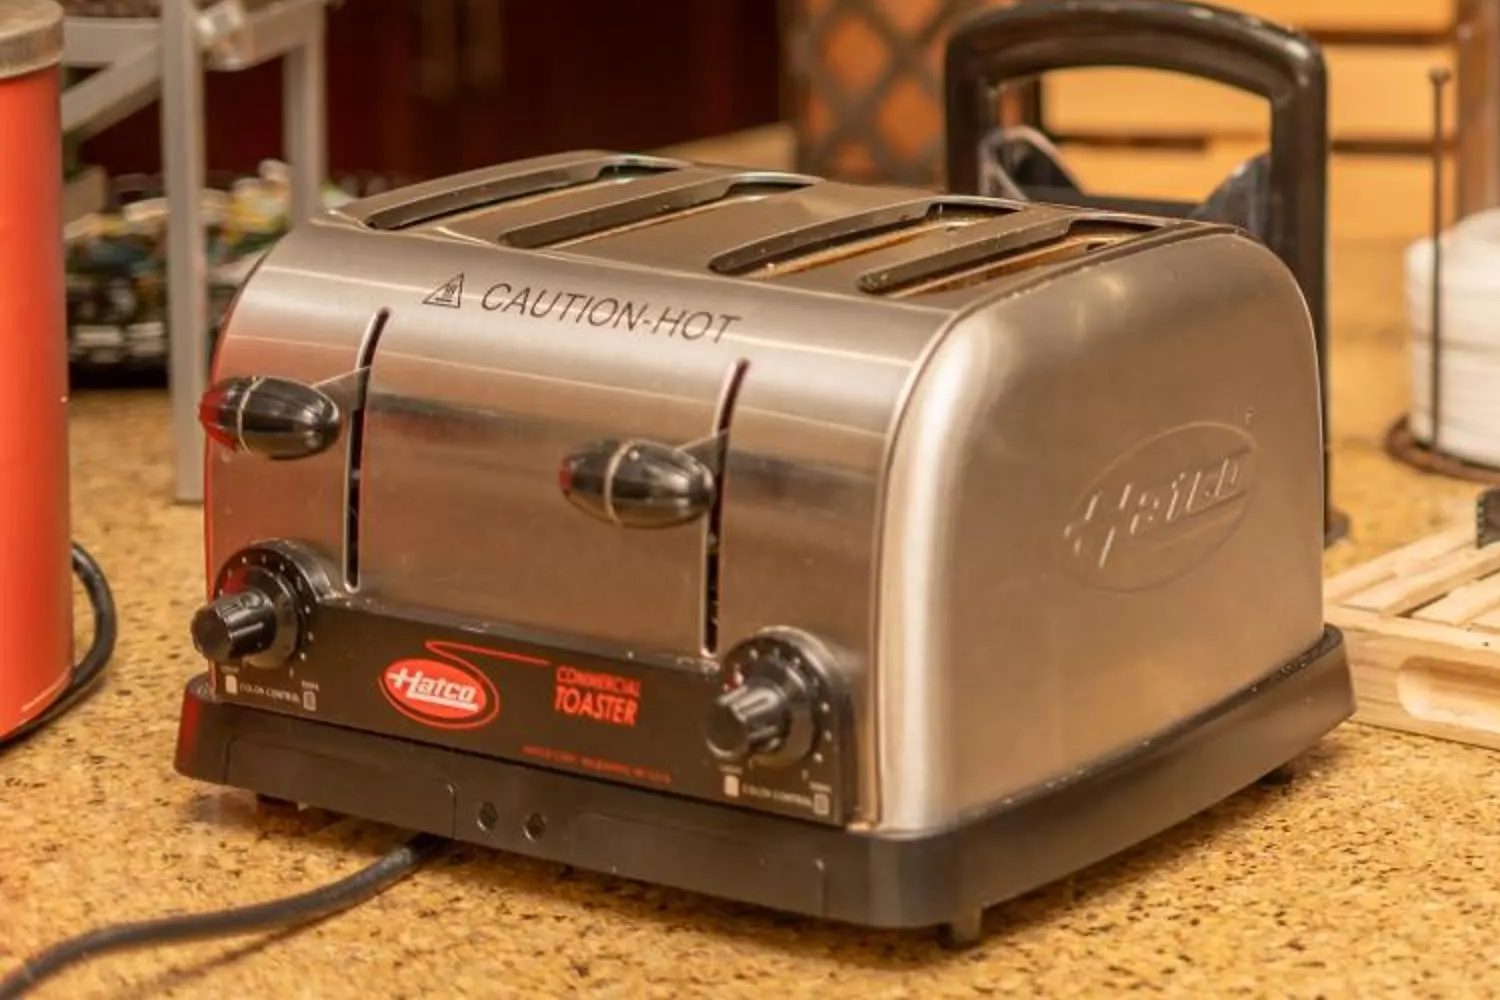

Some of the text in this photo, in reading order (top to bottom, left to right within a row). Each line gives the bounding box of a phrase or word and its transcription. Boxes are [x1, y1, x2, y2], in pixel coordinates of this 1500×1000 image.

[480, 283, 742, 344] CAUTION-HOT
[386, 668, 479, 713] Hatco
[556, 666, 641, 697] COMMERCIAL
[554, 686, 638, 726] TOASTER
